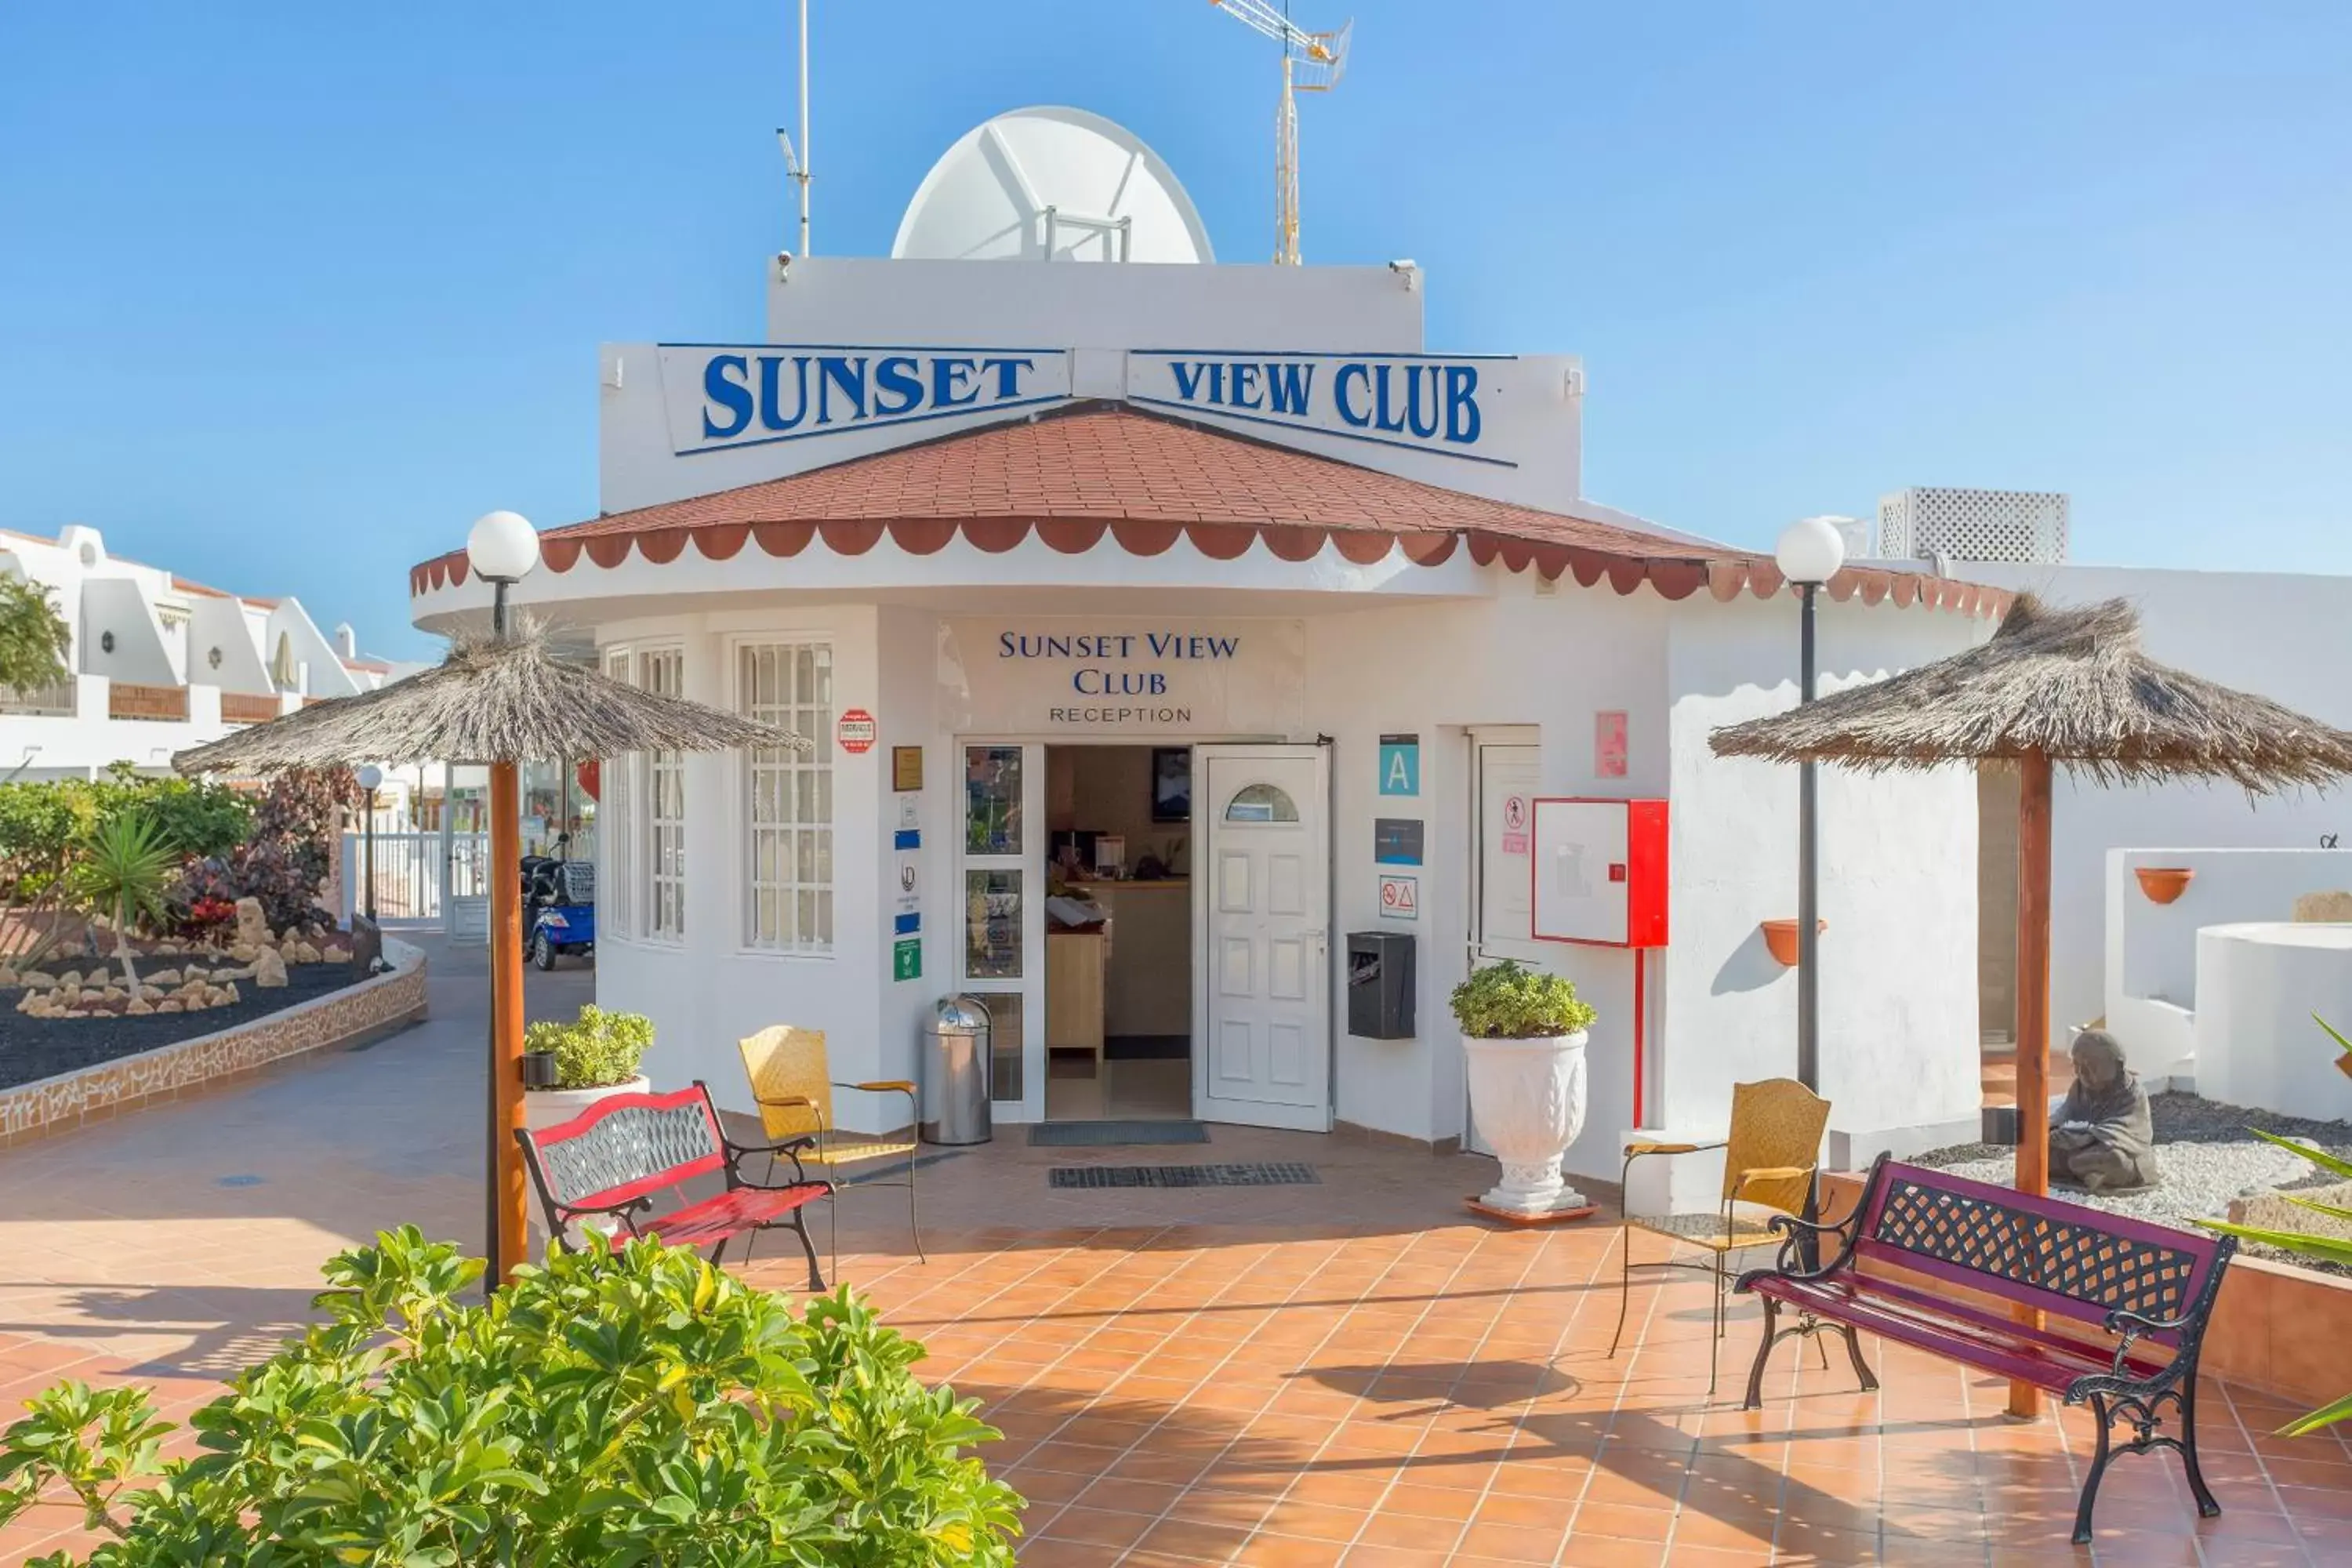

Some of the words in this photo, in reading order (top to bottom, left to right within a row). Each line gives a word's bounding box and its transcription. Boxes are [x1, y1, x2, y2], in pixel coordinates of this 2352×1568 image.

[702, 354, 1034, 441] SUNSET
[1169, 361, 1315, 416] VIEW
[1334, 363, 1482, 444] CLUB
[999, 631, 1135, 659] SUNSET
[1146, 633, 1240, 659] VIEW
[1073, 669, 1167, 695] CLUB
[1050, 708, 1191, 722] RECEPTION
[1388, 750, 1409, 789] A
